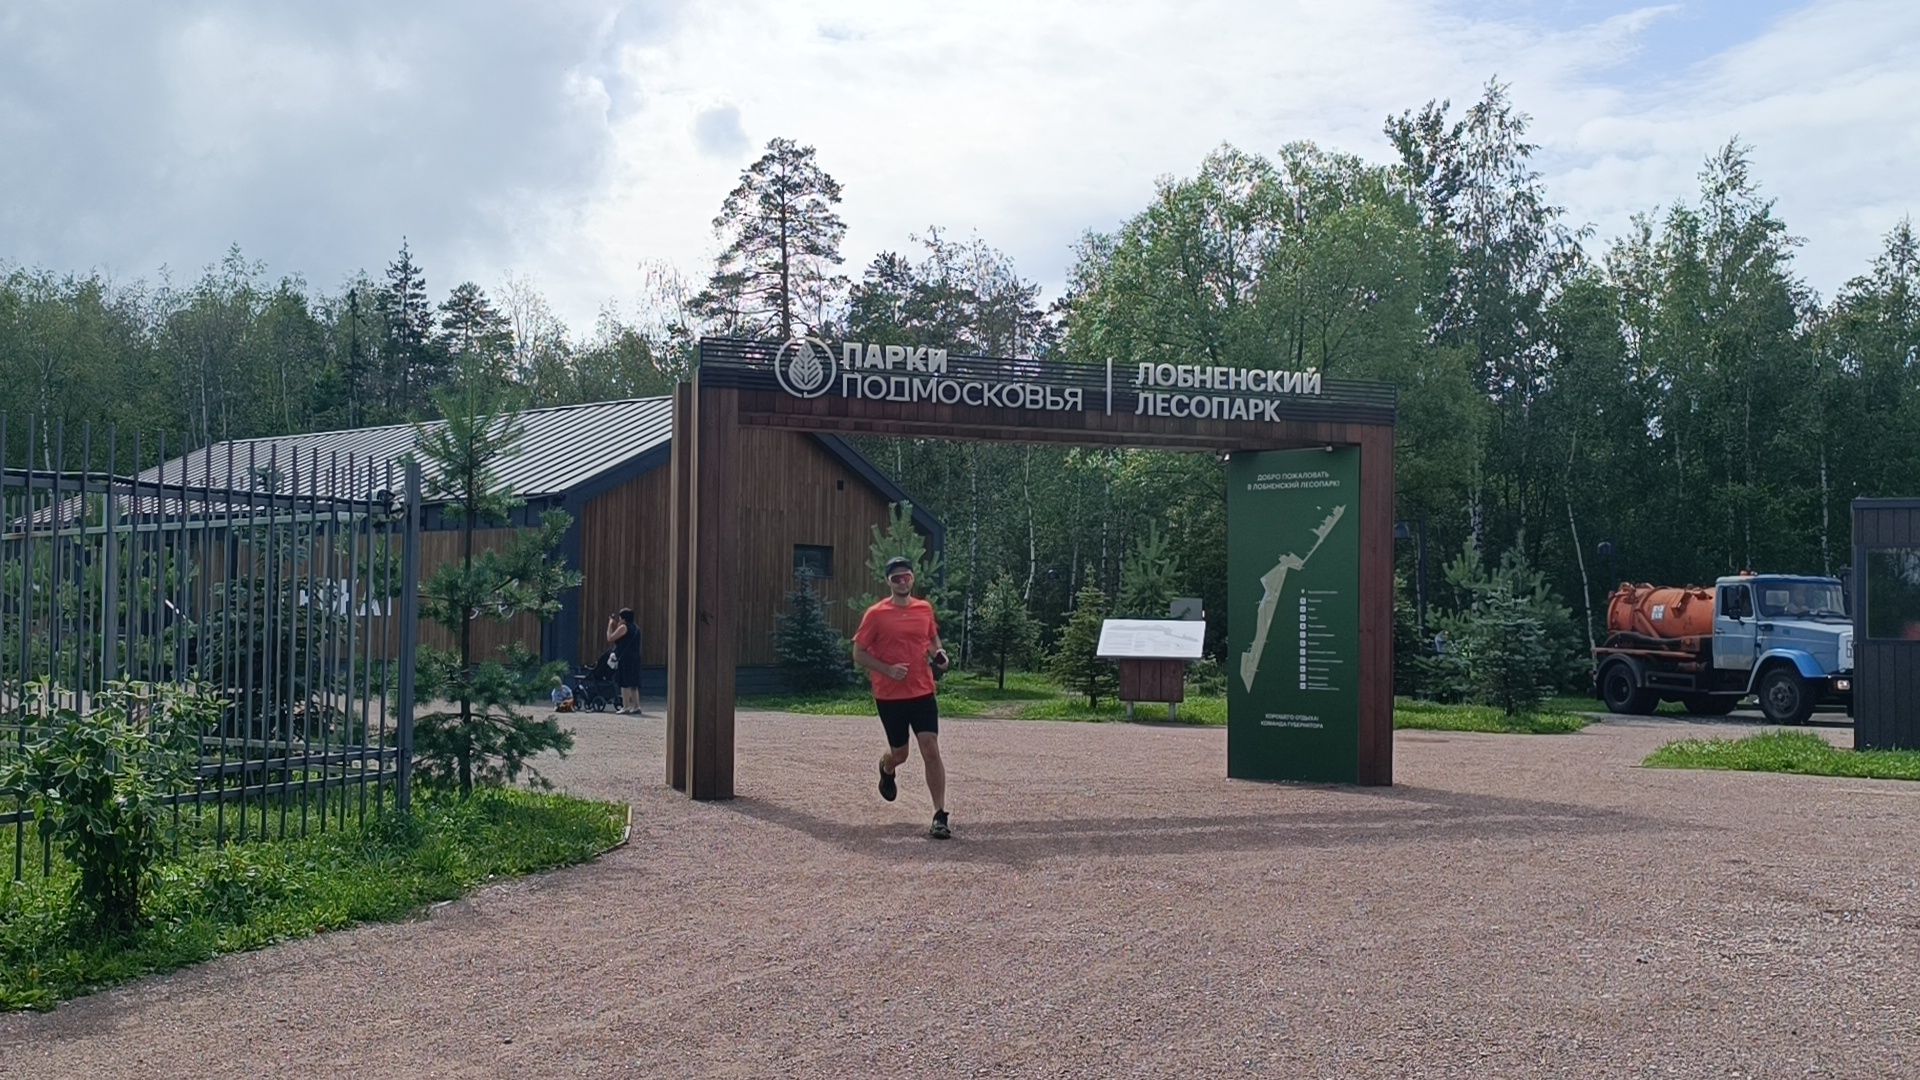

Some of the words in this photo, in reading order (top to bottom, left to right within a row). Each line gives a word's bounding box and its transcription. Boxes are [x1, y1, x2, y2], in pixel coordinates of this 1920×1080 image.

[843, 342, 947, 373] ПАРКИ
[842, 373, 1082, 411] ПОДМОСКОВЬЯ
[1136, 362, 1321, 394] ЛОБНЕНСКИЙ
[1135, 393, 1280, 422] ЛЕСОПАРК
[1253, 481, 1300, 490] ЛОБНЕНСКИЙ
[1257, 473, 1281, 481] ДОБРО
[1282, 471, 1330, 480] ПОЖАЛОВАТЬ
